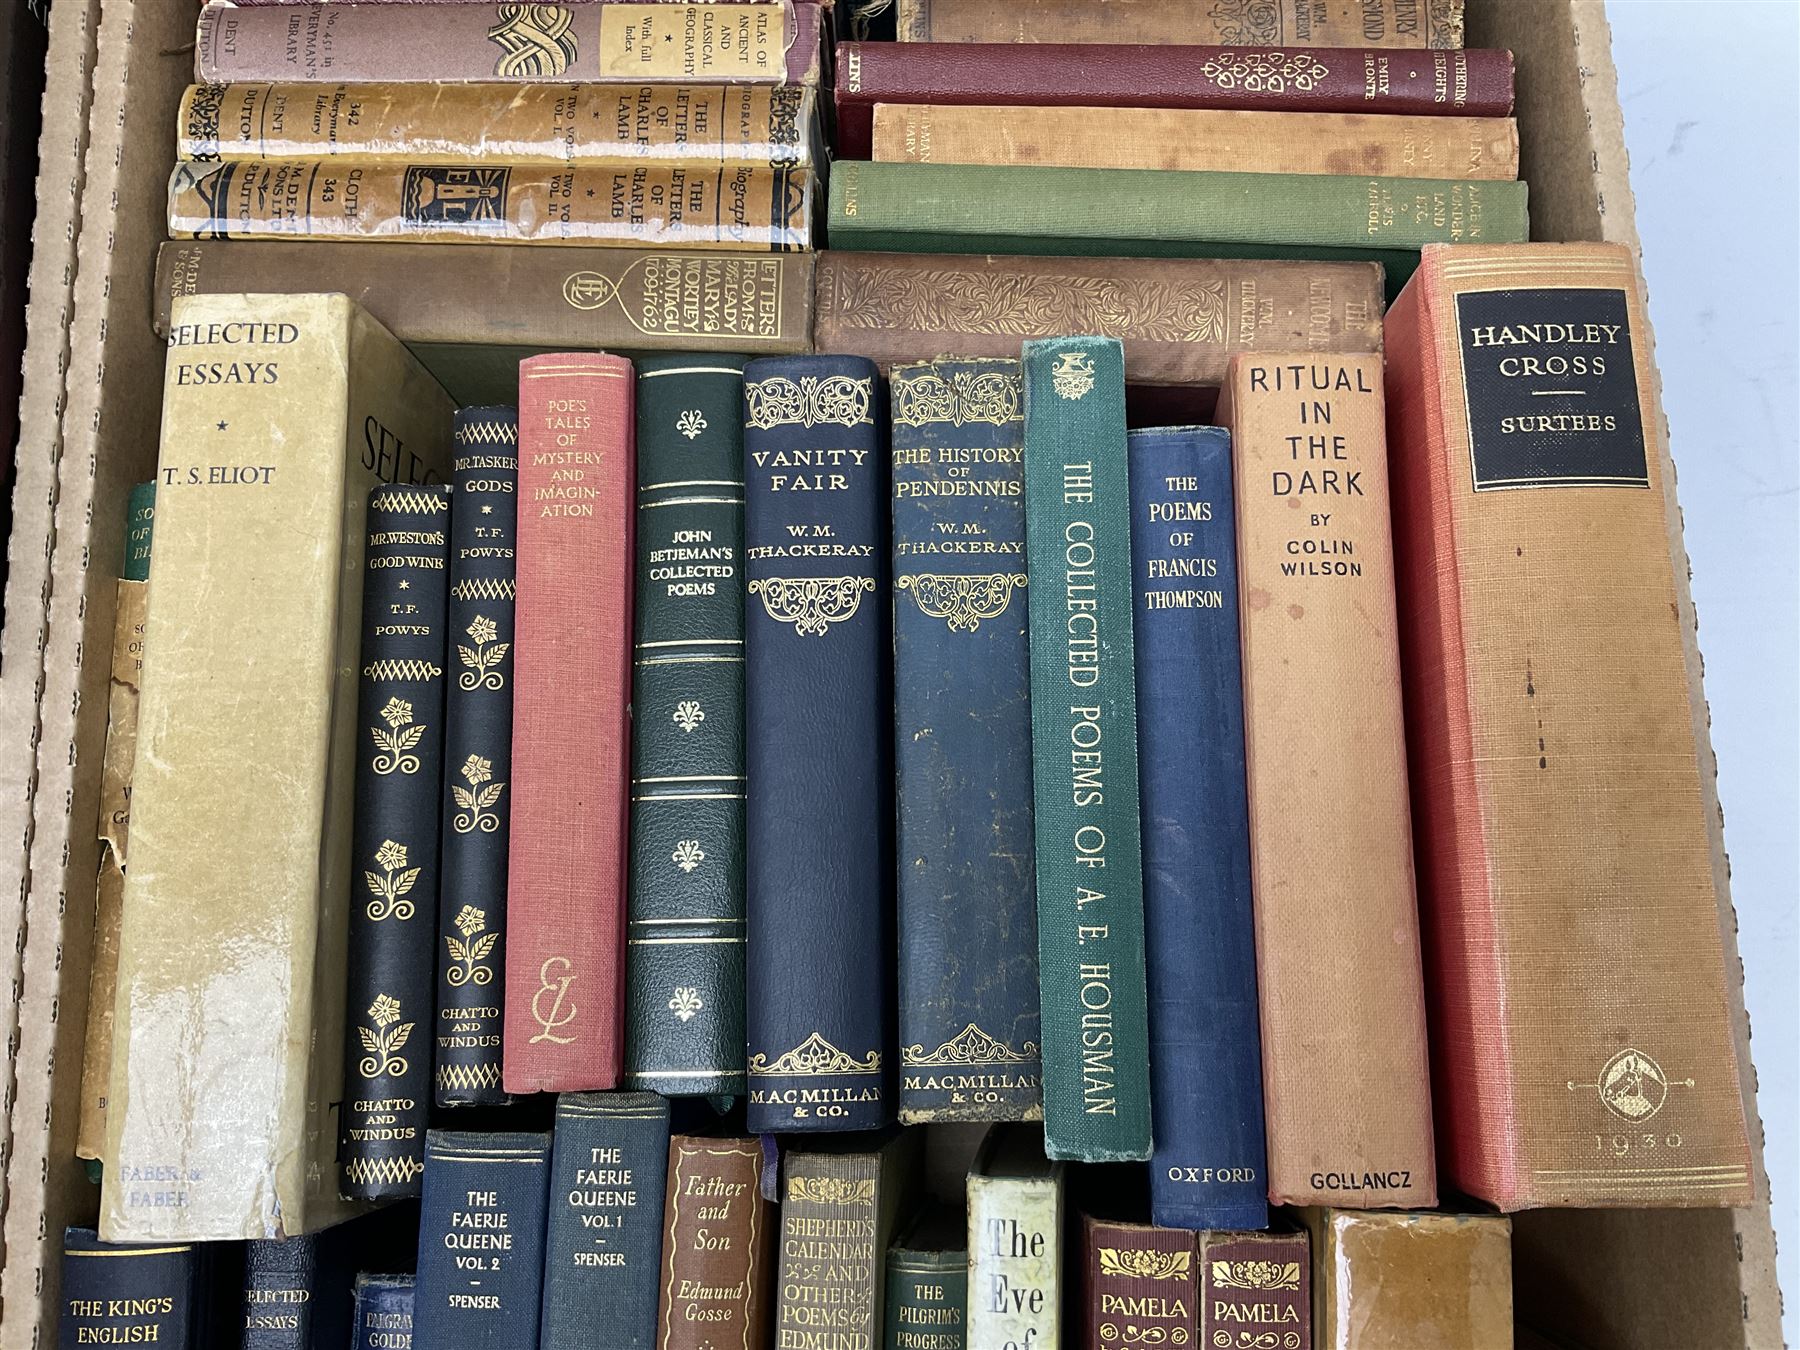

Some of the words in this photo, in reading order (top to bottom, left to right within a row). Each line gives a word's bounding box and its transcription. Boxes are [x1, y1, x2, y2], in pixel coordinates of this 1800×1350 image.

[325, 12, 340, 29] No.
[640, 16, 653, 40] With
[756, 12, 768, 45] ATLAS
[199, 10, 217, 64] DUTTON
[224, 20, 239, 57] DENT
[286, 14, 302, 65] LIBRARY
[305, 4, 323, 79] EVERYMAN'S
[322, 32, 334, 51] 451
[625, 25, 637, 53] Index
[684, 7, 698, 77] GEOGRAPHY
[702, 12, 714, 69] CLASSICAL
[719, 25, 732, 50] AND
[738, 14, 750, 64] ANCIENT
[323, 57, 336, 68] in
[640, 45, 652, 62] full
[756, 50, 768, 69] OF
[1363, 53, 1377, 101] BRONTE
[1378, 58, 1390, 96] EMILY
[271, 96, 288, 134] DENT
[311, 94, 329, 136] Library
[347, 102, 361, 127] 342
[617, 96, 632, 140] LAMB
[636, 87, 653, 155] CHARLES
[656, 106, 669, 127] OF
[675, 88, 690, 153] LETTERS
[694, 101, 709, 134] THE
[321, 178, 337, 203] 343
[344, 169, 363, 219] CLOTH
[612, 174, 628, 219] LAMB
[630, 167, 648, 234] CHARLES
[651, 185, 664, 207] OF
[670, 168, 686, 231] LETTERS
[689, 180, 704, 213] THE
[1433, 192, 1446, 228] LAND
[663, 258, 682, 334] MONTAGU
[682, 259, 702, 333] WORTLEY
[704, 260, 722, 315] MARY
[742, 260, 757, 314] FROM
[759, 260, 778, 336] LETTERS
[1238, 280, 1256, 346] THACKERAY
[1344, 300, 1368, 331] THE
[168, 321, 299, 350] SELECTED
[1471, 322, 1622, 348] HANDLEY
[177, 362, 279, 386] ESSAYS
[1498, 354, 1606, 377] CROSS
[1250, 365, 1373, 394] RITUAL
[548, 400, 587, 414] POE'S
[1299, 401, 1332, 425] IN
[545, 416, 591, 430] TALES
[1500, 414, 1617, 434] SURTEES
[556, 434, 577, 447] OF
[1285, 435, 1347, 461] THE
[533, 451, 604, 466] MYSTERY
[751, 449, 869, 468] VANITY
[893, 449, 931, 465] THE
[938, 447, 1024, 464] HISTORY
[163, 467, 182, 486] T.
[187, 466, 204, 486] S.
[209, 465, 276, 485] ELIOT
[552, 468, 585, 482] AND
[770, 474, 849, 491] FAIR
[948, 466, 970, 478] OF
[1063, 460, 1093, 504] THE
[465, 480, 514, 493] GODS
[535, 486, 602, 500] IMAGIN-
[896, 480, 1022, 498] PENDENNIS
[1165, 476, 1198, 492] THE
[1272, 469, 1364, 497] DARK
[541, 503, 594, 518] ATION
[1149, 502, 1213, 523] POEMS
[1310, 512, 1331, 527] BY
[131, 527, 150, 541] OF
[672, 530, 712, 544] JOHN
[1169, 532, 1194, 547] OF
[460, 547, 514, 559] POWYS
[650, 547, 733, 563] BETJEMAN'S
[748, 544, 874, 559] THACKERAY
[898, 541, 1024, 555] THACKERAY
[1286, 539, 1354, 556] COLIN
[370, 556, 405, 569] GOOD
[406, 557, 444, 569] WINE
[1148, 558, 1218, 579] FRANCIS
[1280, 560, 1363, 578] WILSON
[650, 565, 734, 582] COLLECTED
[667, 582, 716, 597] POEMS
[1144, 590, 1223, 610] THOMPSON
[1064, 520, 1101, 688] COLLECTED
[375, 625, 431, 636] POWYS
[1071, 705, 1104, 806] POEMS
[1074, 825, 1106, 868] OF
[1077, 885, 1106, 912] A.
[1078, 923, 1109, 946] E.
[441, 1006, 499, 1020] CHATTO
[453, 1022, 481, 1032] AND
[438, 1035, 501, 1048] WINDUS
[1078, 962, 1117, 1117] HOUSMAN
[354, 1098, 415, 1113] CHATTO
[751, 1086, 882, 1104] MACMILLAN
[951, 1091, 966, 1104] &
[974, 1090, 1005, 1103] CO.
[366, 1114, 397, 1125] AND
[793, 1106, 809, 1118] &
[817, 1104, 850, 1117] CO.
[350, 1128, 416, 1141] WINDUS
[590, 1147, 622, 1164] THE
[121, 1166, 178, 1183] FABER
[576, 1169, 632, 1186] FAERIE
[1167, 1166, 1256, 1183] OXFORD
[1310, 1171, 1412, 1190] GOLLANCZ
[684, 1174, 747, 1197] Father
[467, 1191, 498, 1207] THE
[568, 1190, 637, 1208] QUEENE
[452, 1212, 509, 1229] FAERIE
[581, 1214, 614, 1228] VOL.
[616, 1214, 623, 1228] 1
[697, 1200, 729, 1221] and
[786, 1216, 875, 1238] SHEPHERD'S
[444, 1233, 513, 1251] QUEENE
[693, 1228, 731, 1251] Son
[986, 1217, 1046, 1259] The
[573, 1252, 626, 1267] SPENSER
[785, 1239, 874, 1260] CALENDAR
[455, 1256, 488, 1270] VOL.
[490, 1257, 501, 1270] 2
[825, 1264, 869, 1282] AND
[676, 1279, 743, 1301] Edmund
[784, 1284, 854, 1305] OTHER
[914, 1284, 945, 1301] THE
[986, 1273, 1044, 1315] Eve
[69, 1300, 103, 1317] THE
[108, 1297, 173, 1317] KING'S
[449, 1294, 501, 1310] SPENSER
[684, 1302, 733, 1322] Gosse
[1101, 1294, 1188, 1319] PAMELA
[1214, 1300, 1300, 1323] PAMELA
[245, 1315, 299, 1329] ESSAYS
[782, 1305, 846, 1326] POEMS
[899, 1304, 961, 1326] PILGRIM'S
[77, 1324, 158, 1344] ENGLISH
[779, 1328, 869, 1350] EDMUND
[896, 1331, 961, 1350] PROGRESS
[1001, 1326, 1038, 1350] of
